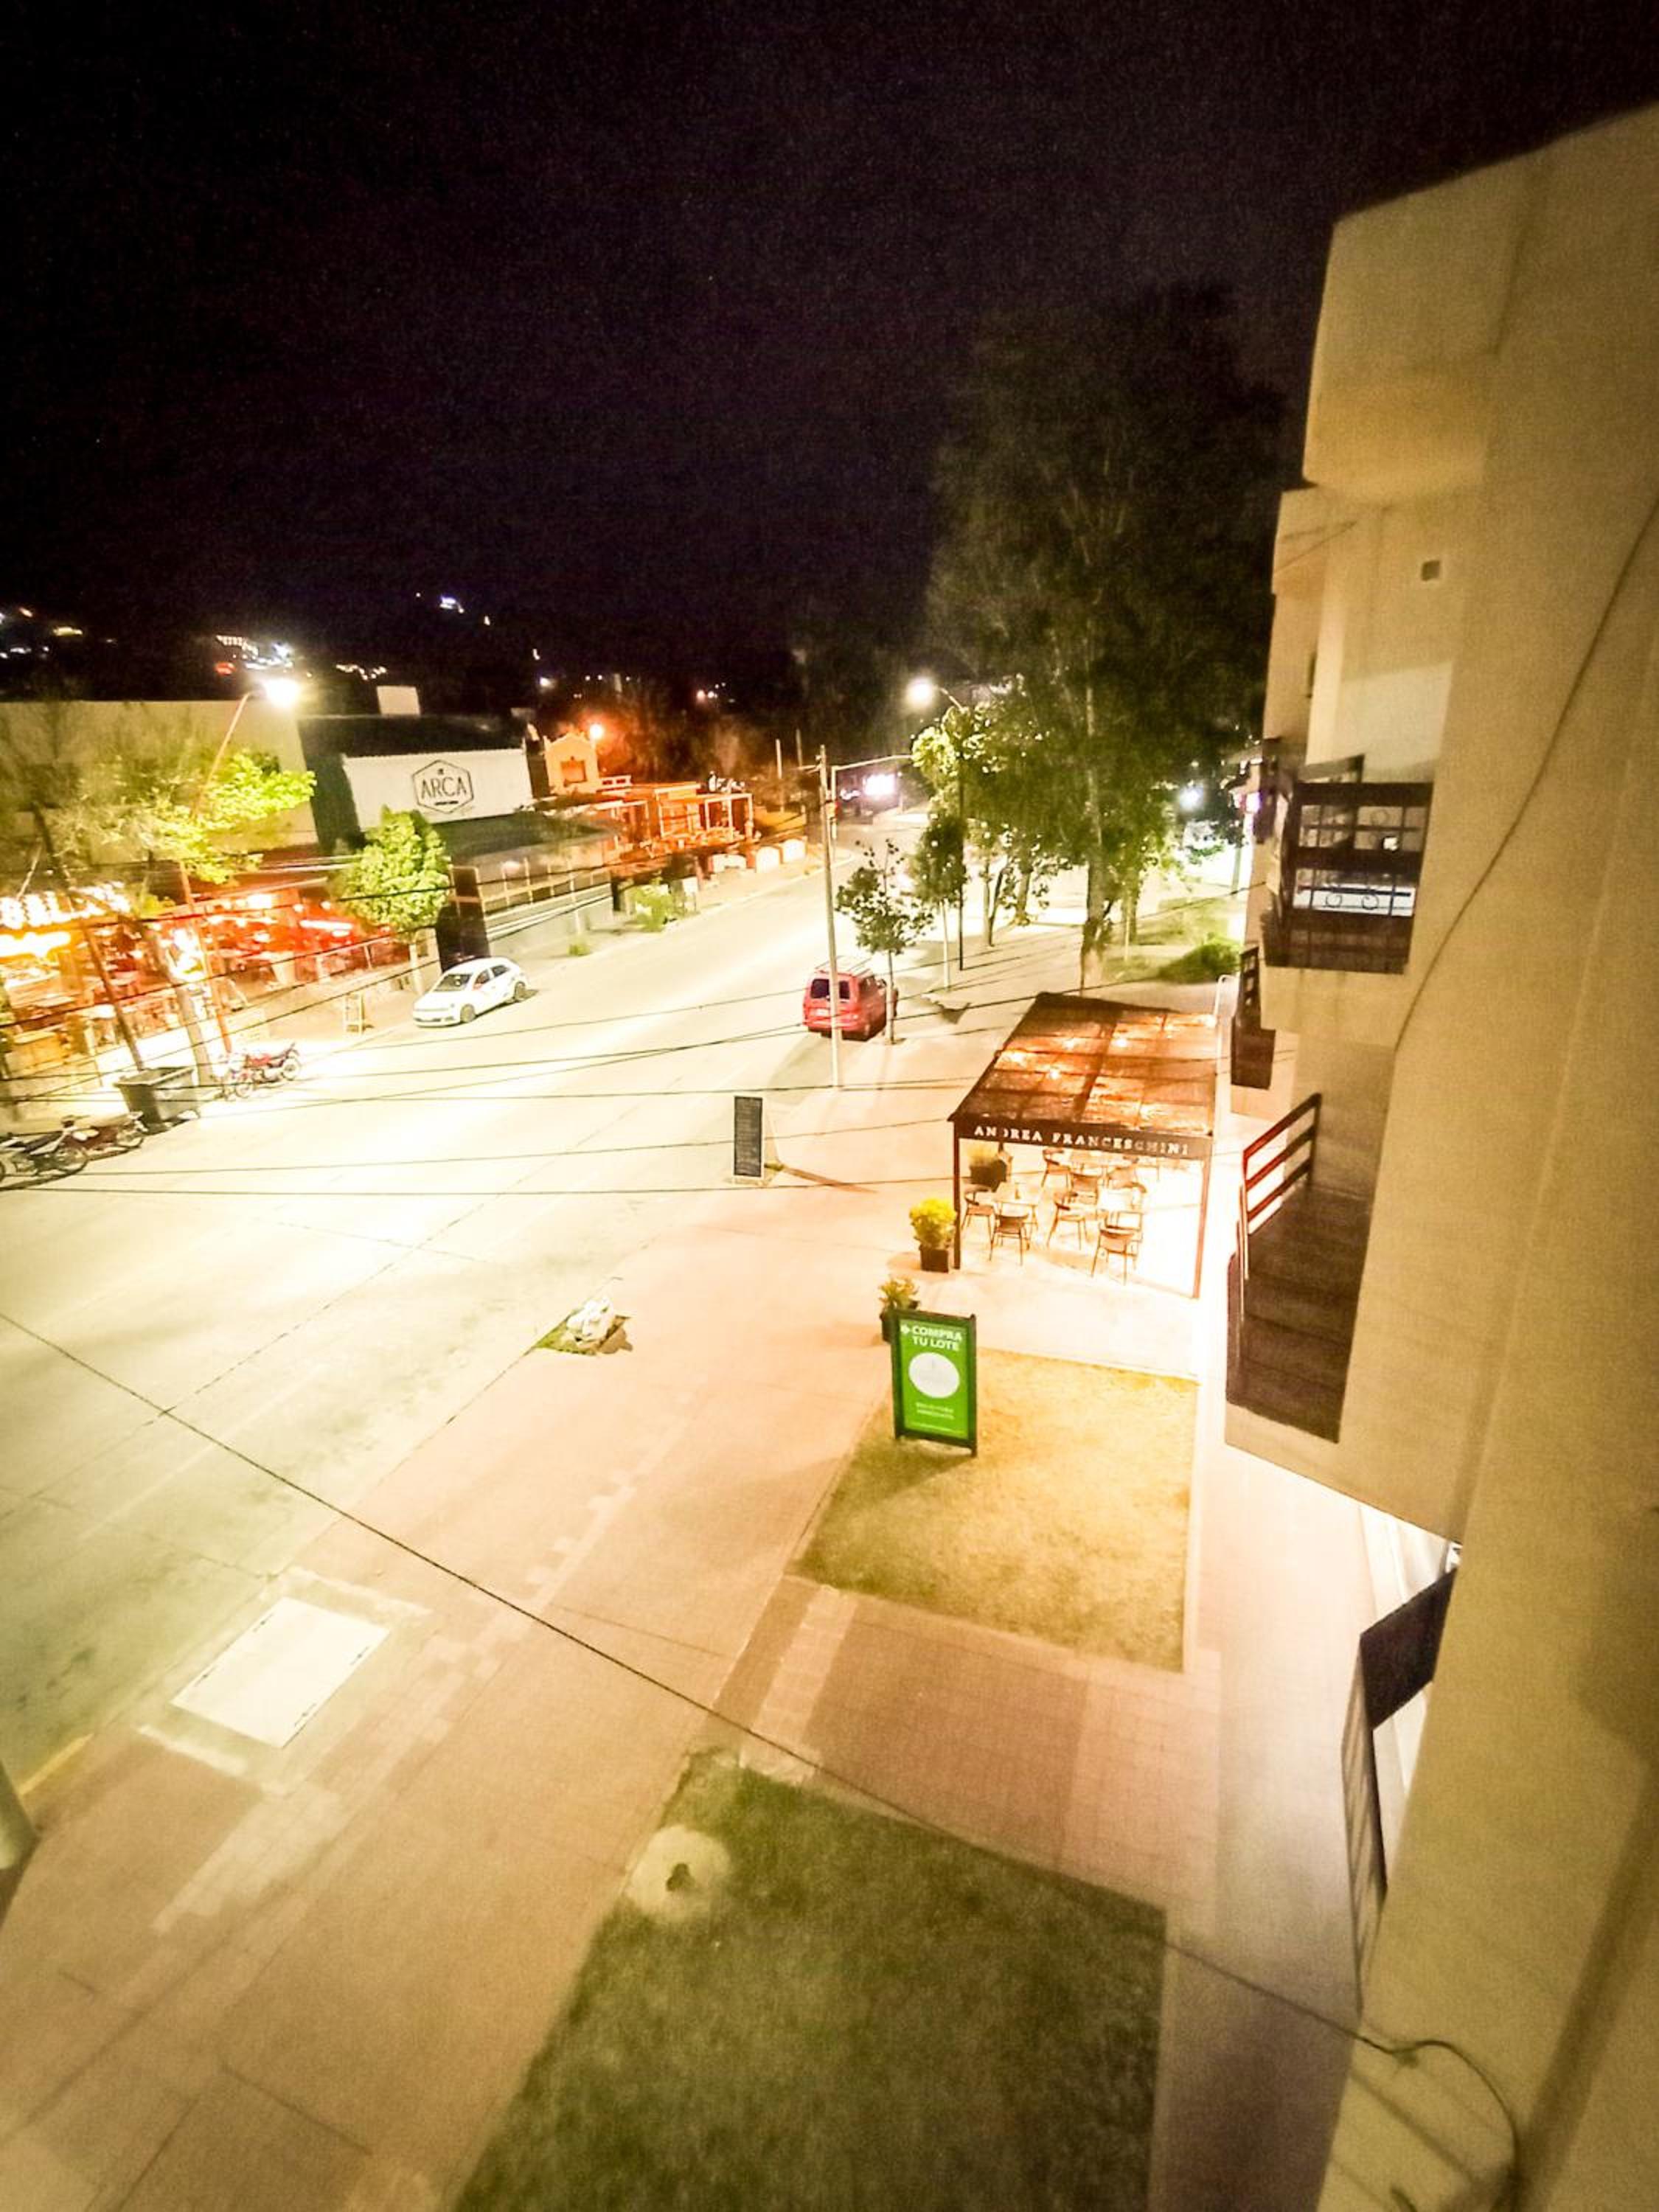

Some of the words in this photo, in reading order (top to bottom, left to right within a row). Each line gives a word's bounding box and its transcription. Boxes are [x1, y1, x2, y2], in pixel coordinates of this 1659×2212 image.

[421, 776, 467, 799] ARCA
[1052, 1133, 1189, 1155] FRANCESCHINI
[912, 1325, 961, 1341] COMPRA
[913, 1335, 928, 1346] TU
[930, 1338, 959, 1351] LOTE
